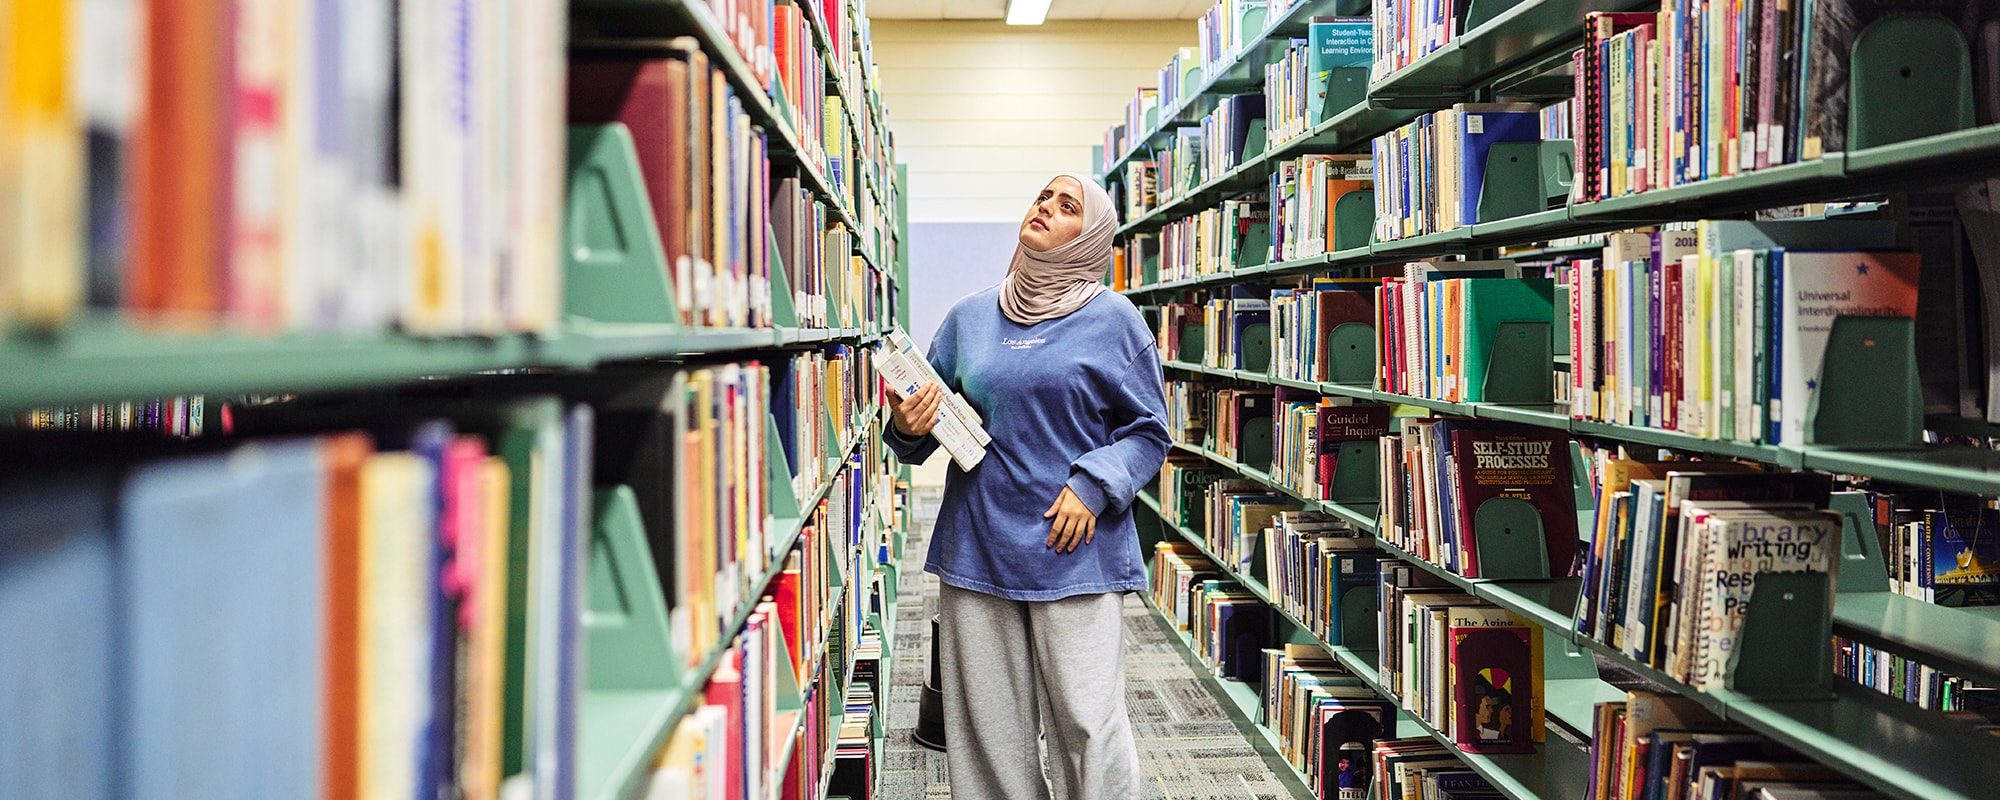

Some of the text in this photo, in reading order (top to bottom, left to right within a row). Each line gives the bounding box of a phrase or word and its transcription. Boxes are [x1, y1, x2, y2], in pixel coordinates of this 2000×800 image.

[1321, 47, 1349, 55] Learning
[1571, 267, 1579, 310] CRAZY
[1652, 270, 1660, 299] CLEP
[1798, 290, 1851, 301] Universal
[1001, 337, 1046, 346] Los Angeles
[1327, 413, 1369, 425] Guided
[1472, 441, 1552, 455] SELF-STUDY
[1476, 455, 1549, 469] PROCESSES
[1727, 540, 1811, 561] Writing
[1455, 617, 1514, 627] The Aging
